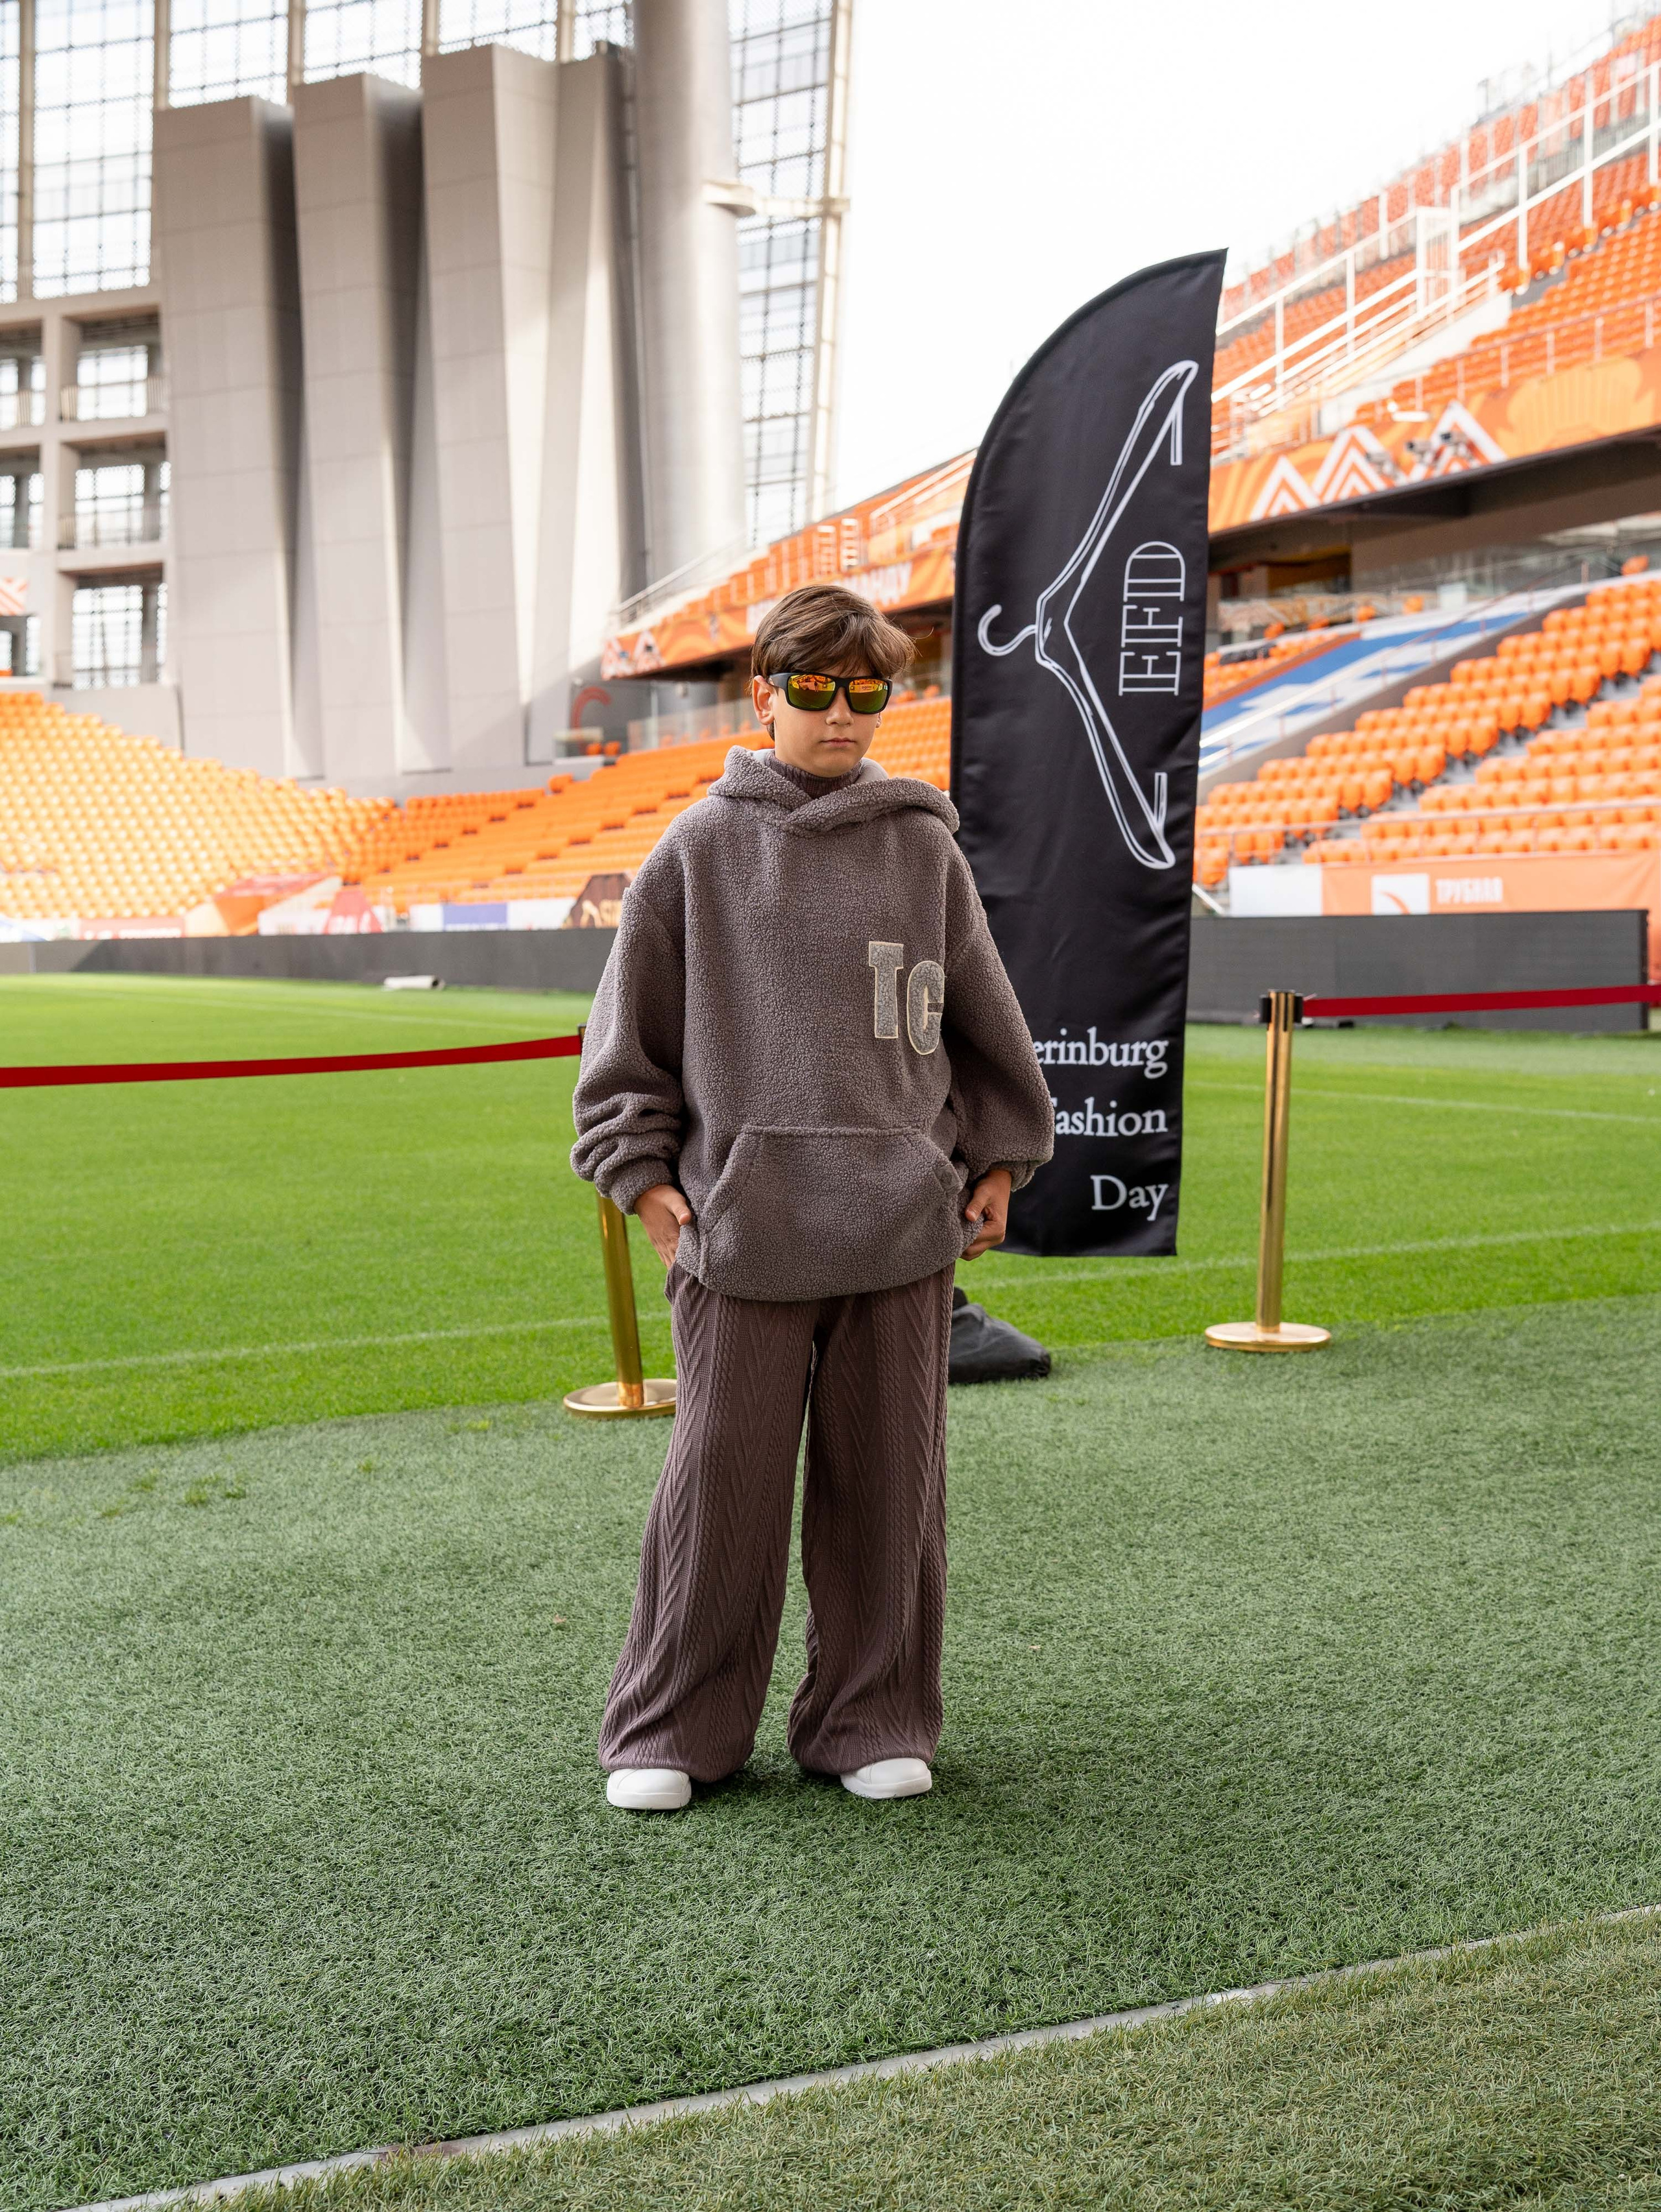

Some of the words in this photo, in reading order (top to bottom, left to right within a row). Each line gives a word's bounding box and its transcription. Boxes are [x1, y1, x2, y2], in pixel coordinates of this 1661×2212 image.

[1118, 541, 1186, 696] EFD
[1032, 1026, 1169, 1079] erinburg
[1051, 1096, 1169, 1136] ashion
[1090, 1175, 1169, 1221] Day
